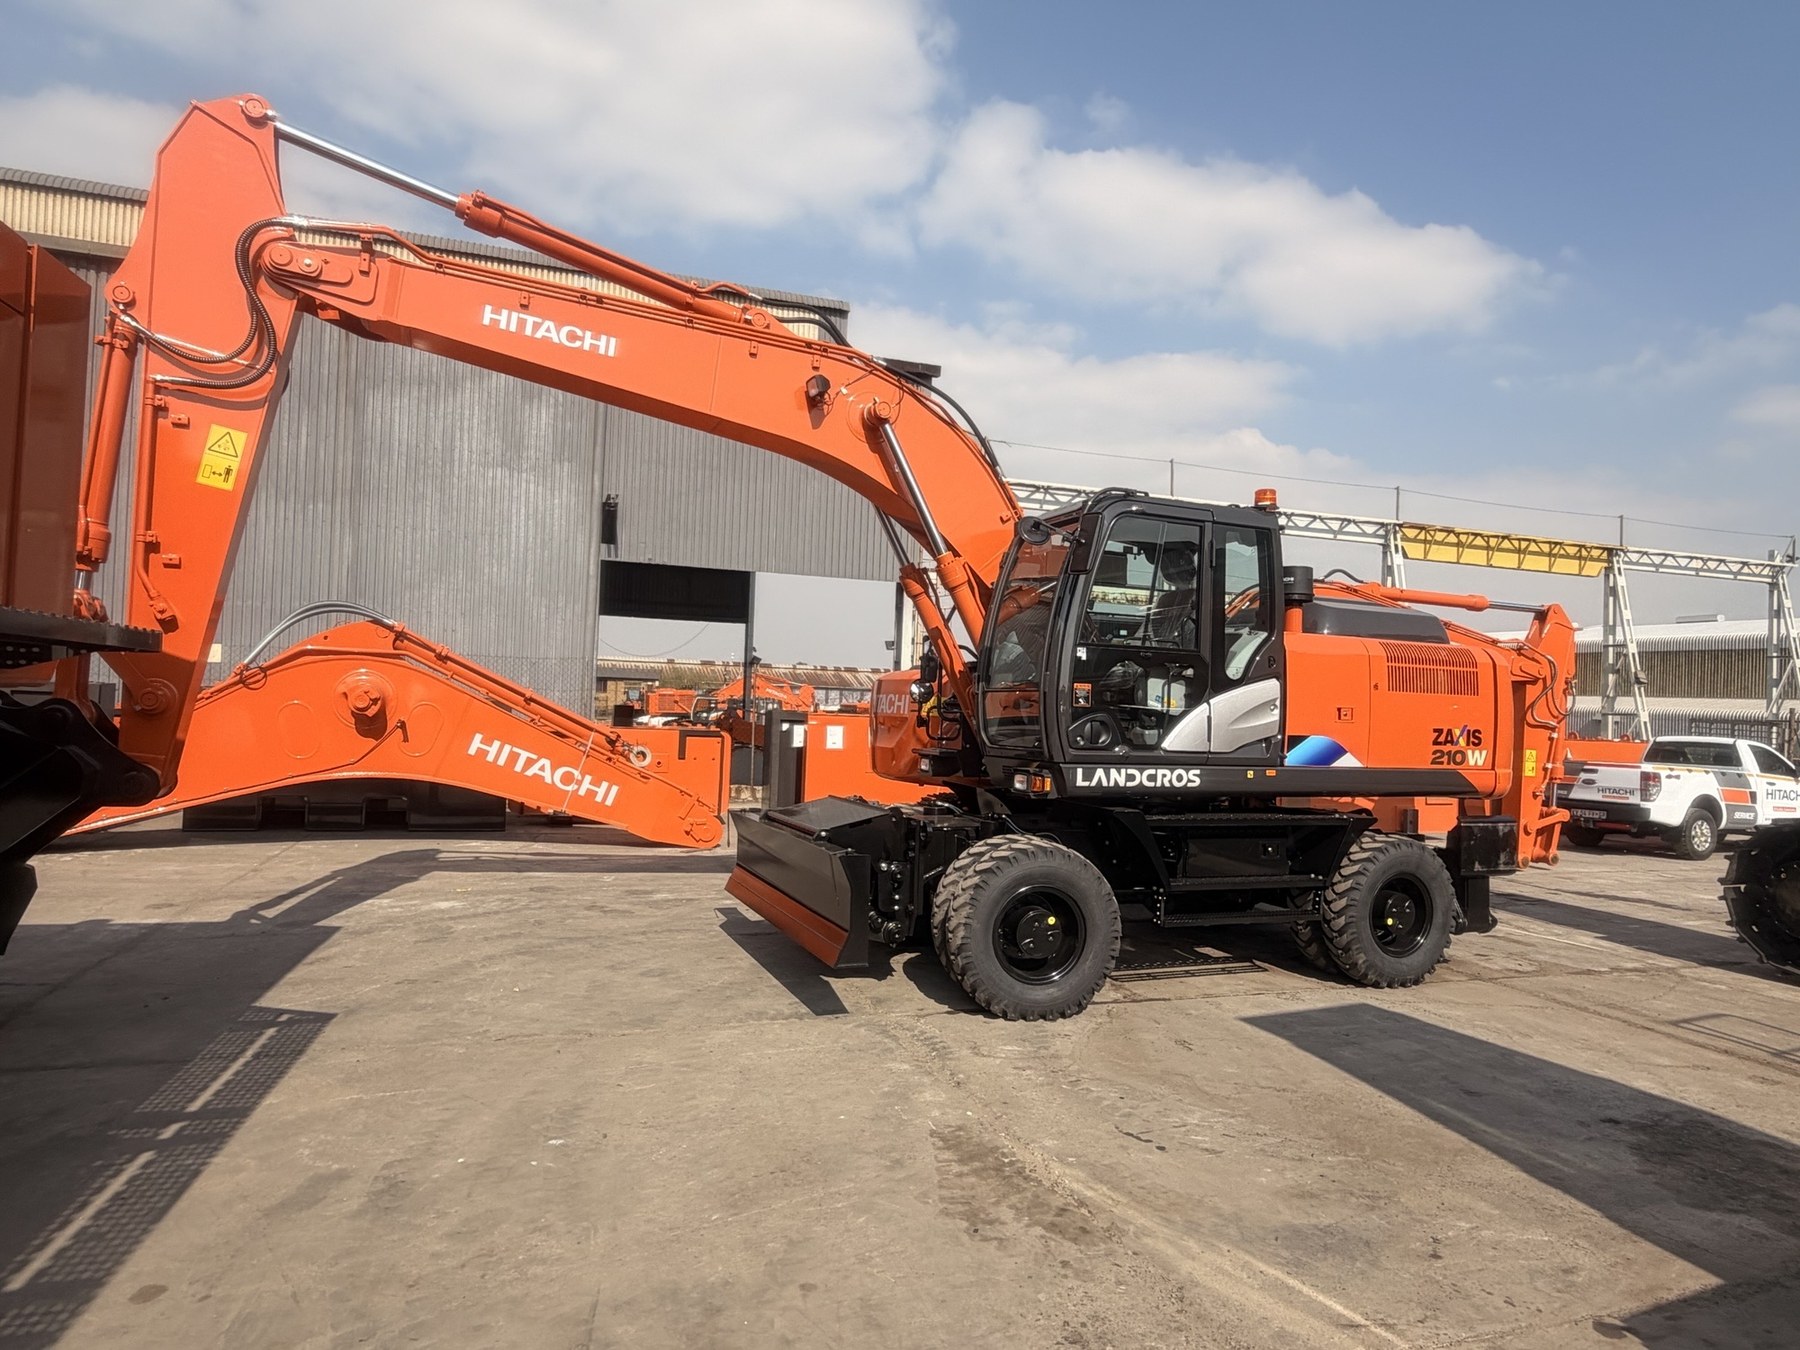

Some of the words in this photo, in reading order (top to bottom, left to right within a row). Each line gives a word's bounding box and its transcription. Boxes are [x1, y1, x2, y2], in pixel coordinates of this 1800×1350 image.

[482, 304, 617, 357] HITACHI
[1432, 724, 1482, 747] ZAXIS
[1430, 749, 1488, 766] 210W
[467, 732, 619, 807] HITACHI
[1076, 768, 1200, 787] LANDCROS
[1597, 787, 1634, 796] HITACHI
[1733, 811, 1756, 820] SERVICE
